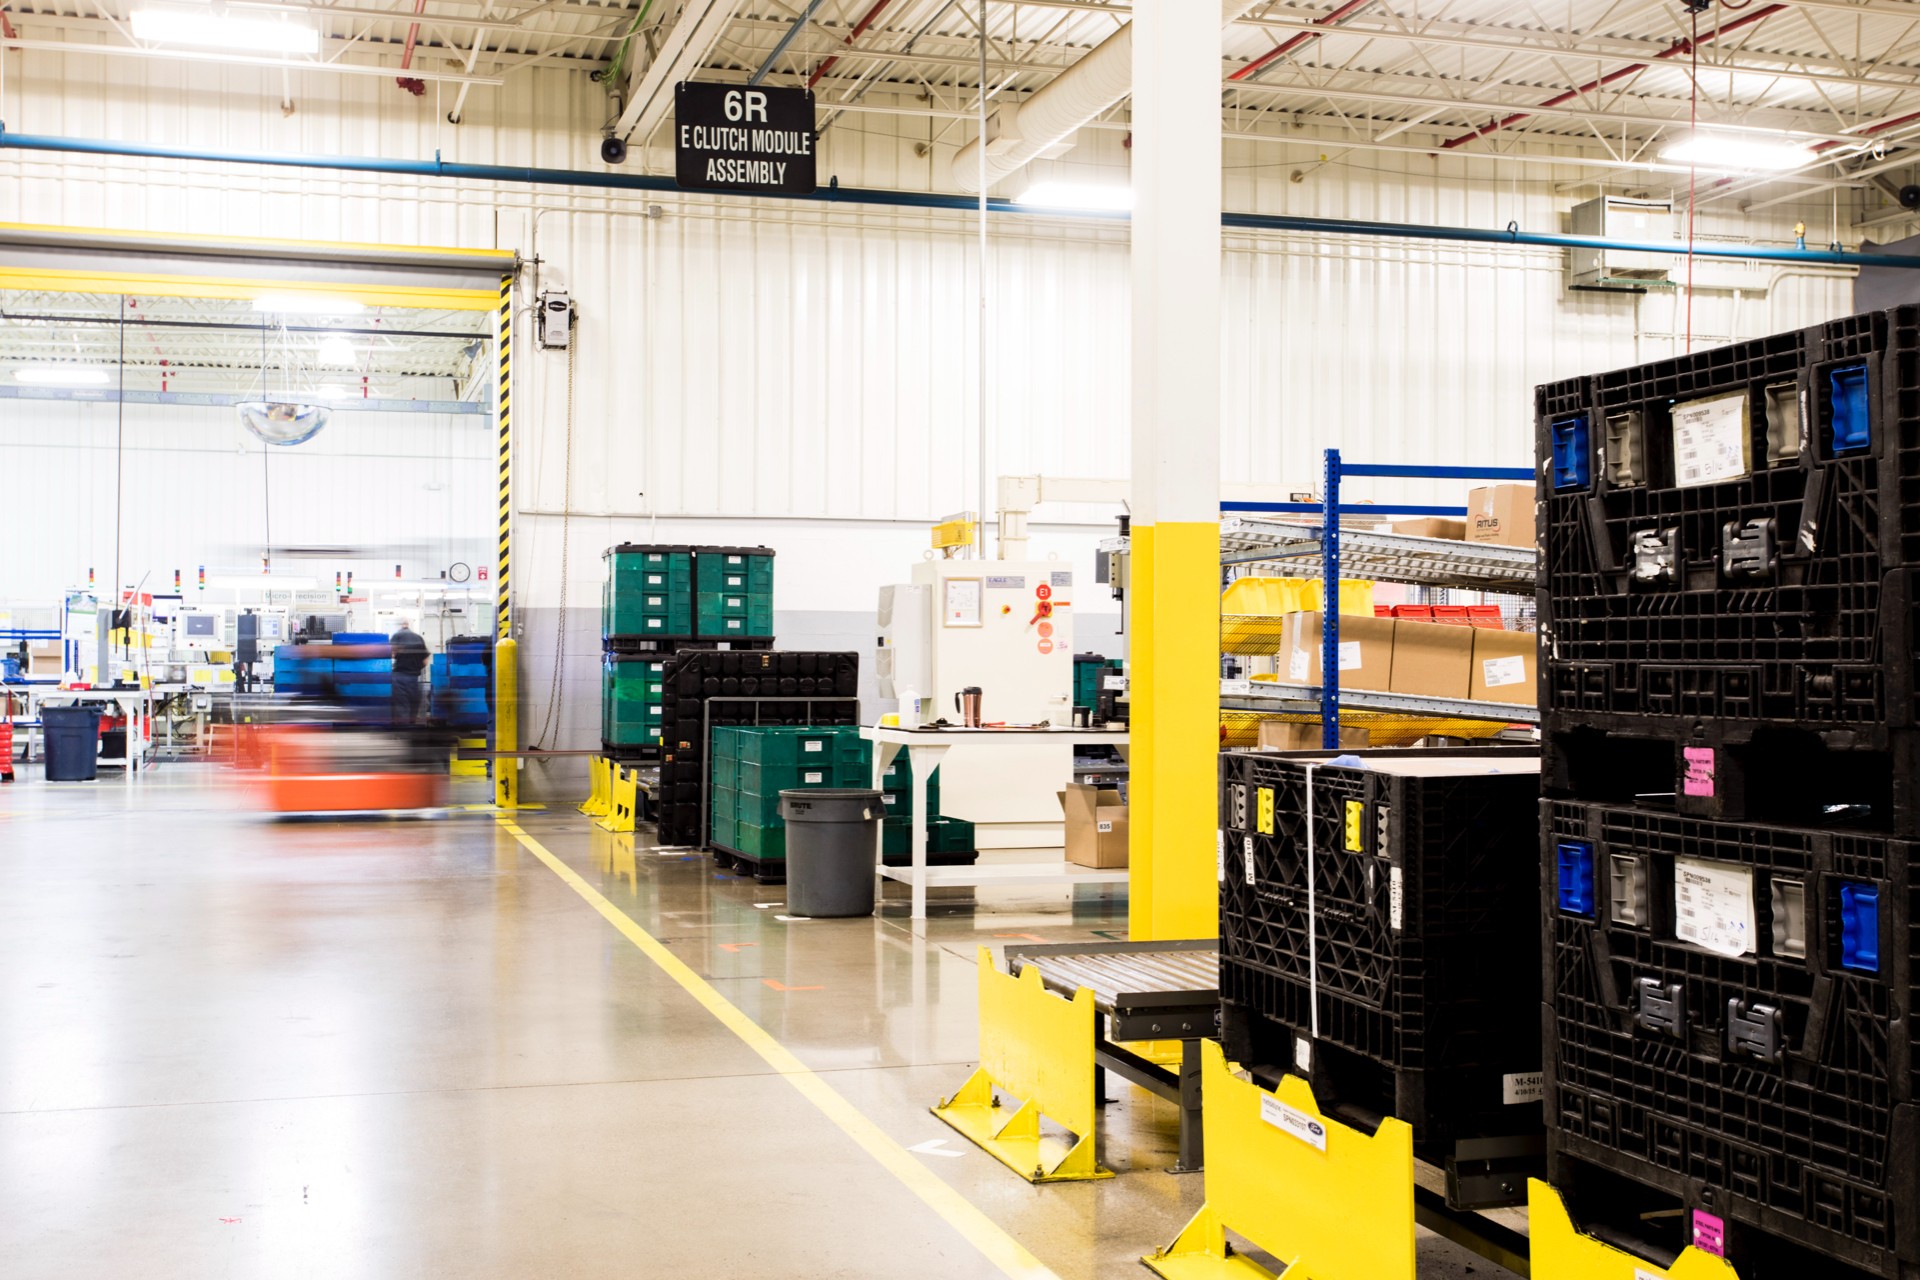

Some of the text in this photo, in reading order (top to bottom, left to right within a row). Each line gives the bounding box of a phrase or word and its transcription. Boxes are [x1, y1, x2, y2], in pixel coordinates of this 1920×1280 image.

[724, 90, 768, 122] 6R
[681, 125, 811, 155] E CLUTCH MODULE
[706, 158, 787, 185] ASSEMBLY
[1039, 588, 1049, 597] E1
